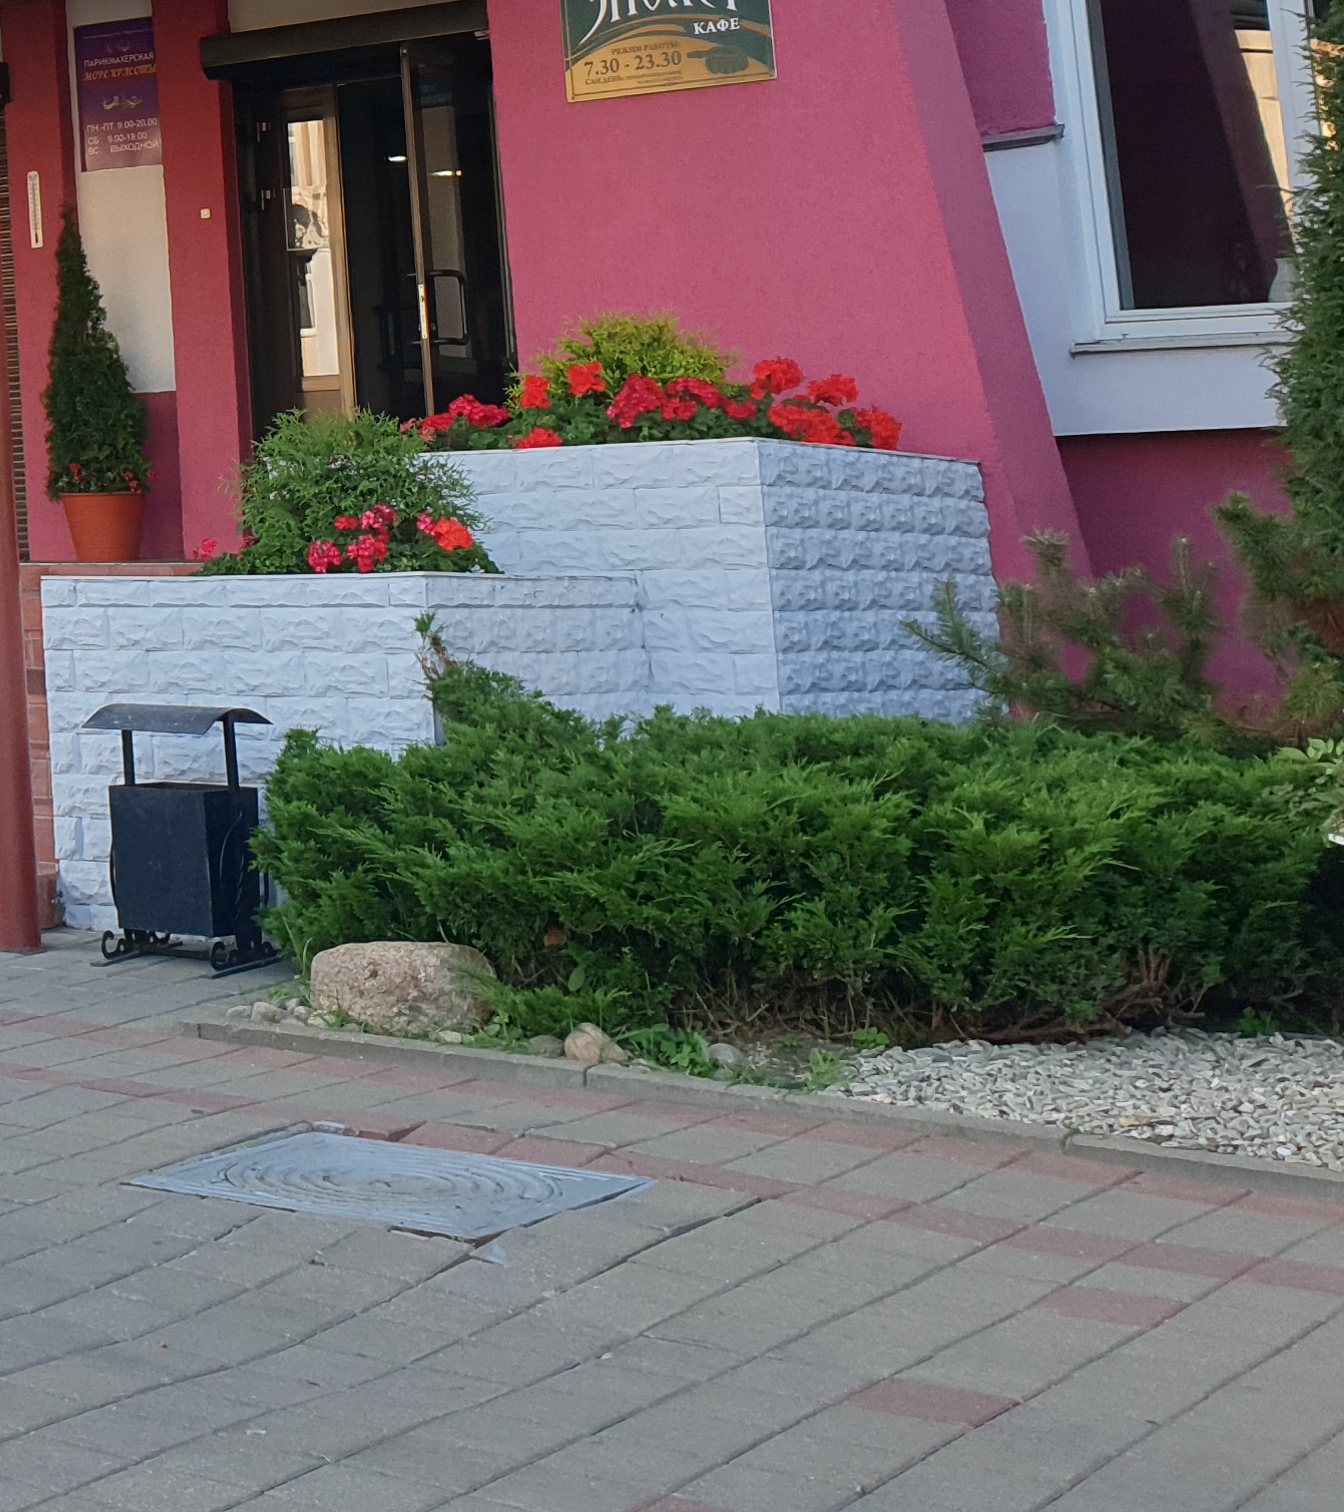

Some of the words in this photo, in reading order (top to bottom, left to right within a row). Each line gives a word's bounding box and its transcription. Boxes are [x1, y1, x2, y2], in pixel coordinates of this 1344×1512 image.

[693, 17, 741, 35] КАФЕ
[83, 52, 154, 67] ПАРИКМАХЕРСКАЯ
[584, 57, 620, 77] 7.30
[633, 50, 682, 70] 23.30
